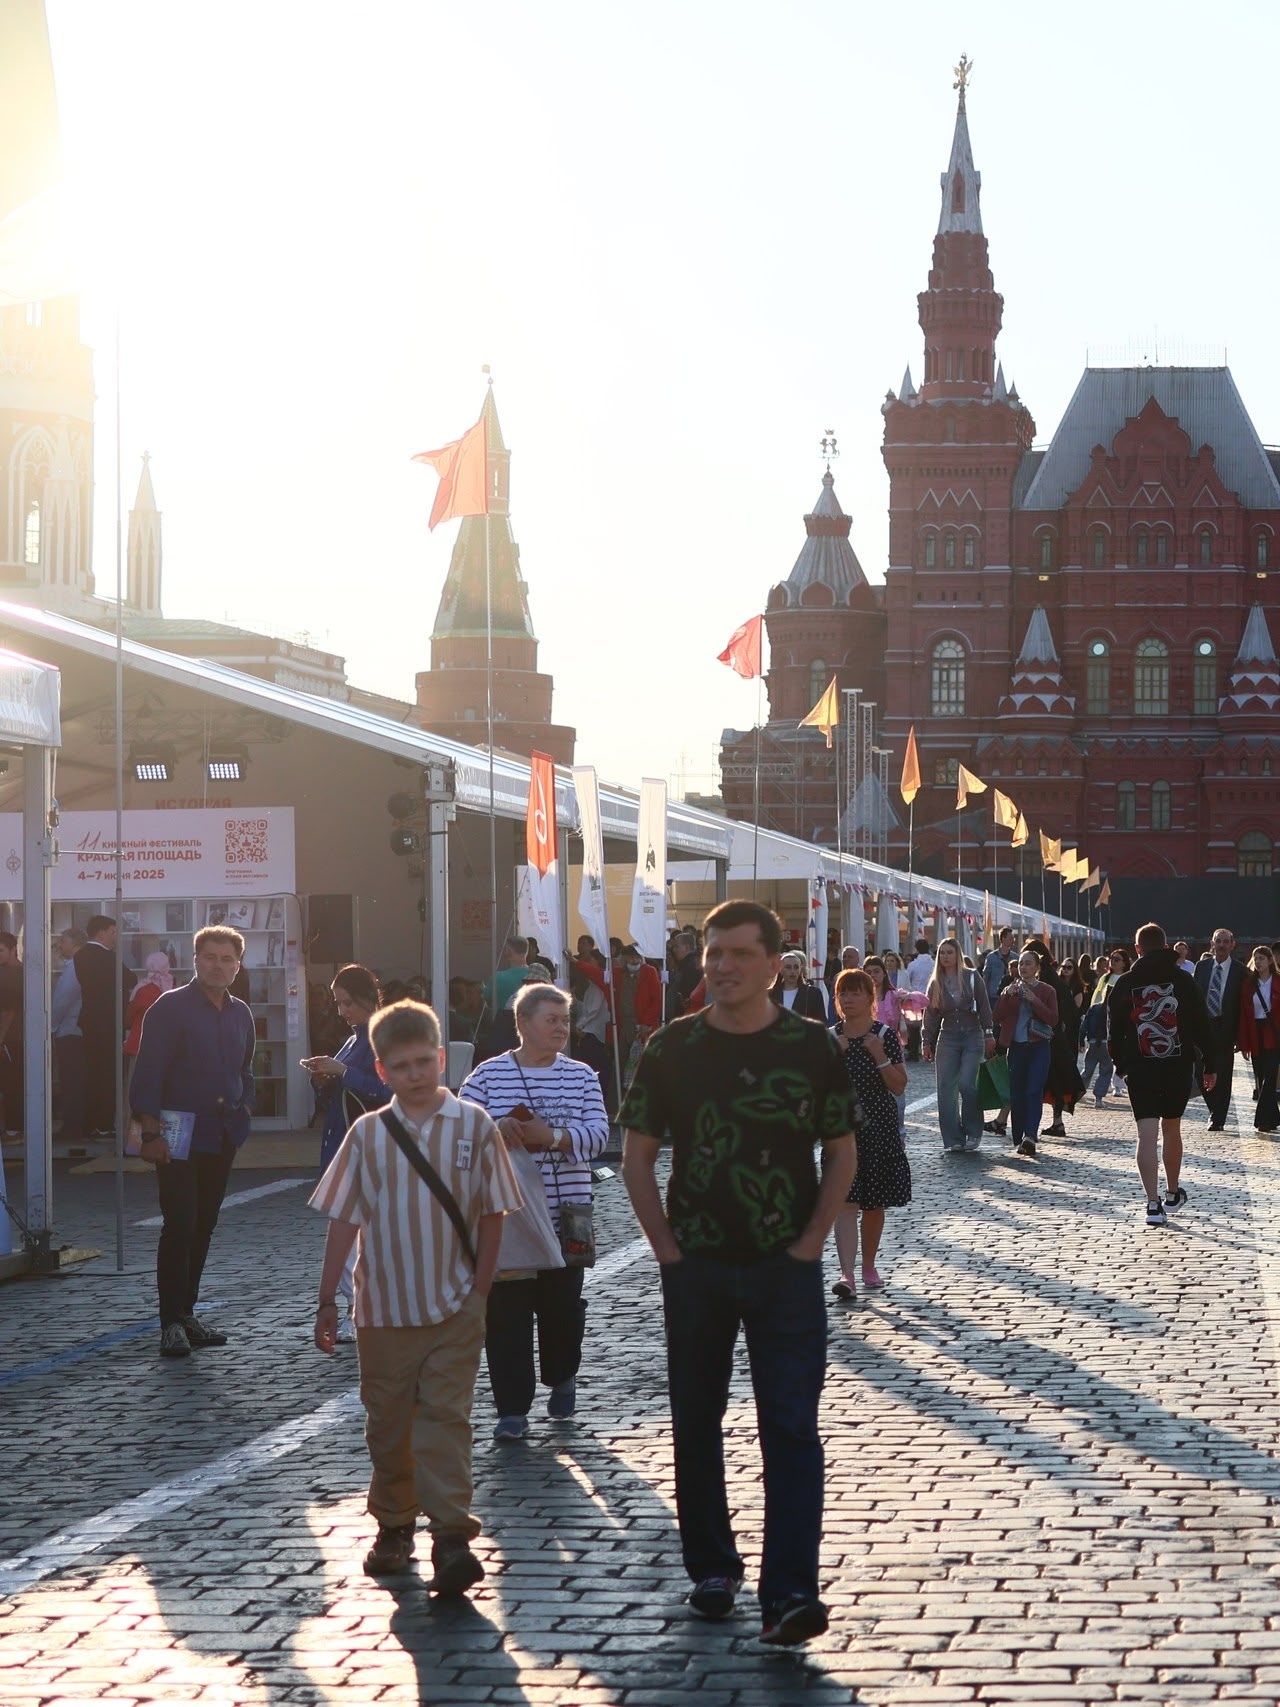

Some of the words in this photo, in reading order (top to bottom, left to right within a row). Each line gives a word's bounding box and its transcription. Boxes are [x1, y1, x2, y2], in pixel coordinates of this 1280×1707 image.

[77, 831, 101, 850] 11
[149, 839, 202, 848] ФЕСТИВАЛЬ
[137, 850, 202, 862] ПЛОЩАДЬ
[133, 869, 165, 880] 2025
